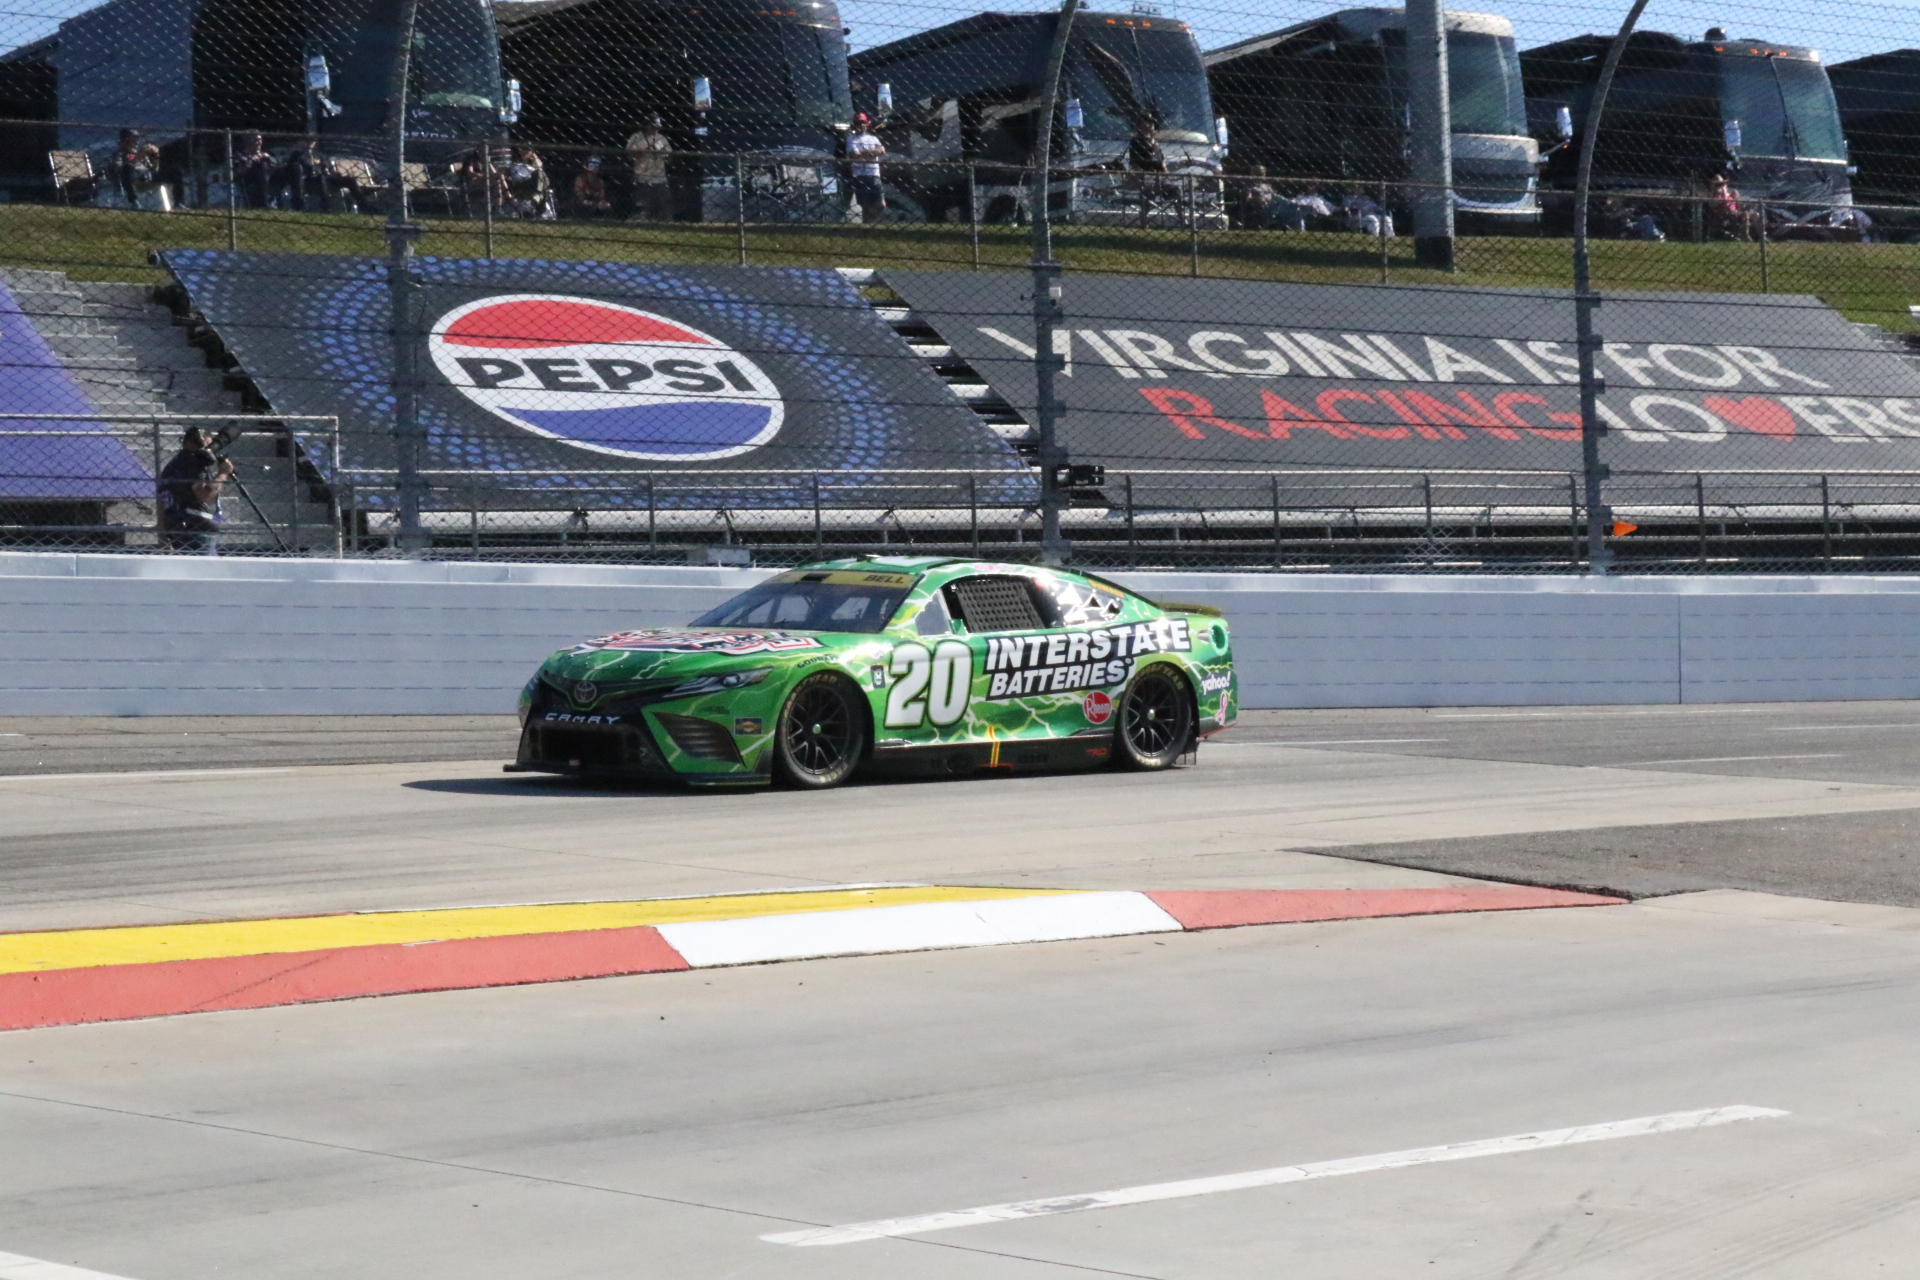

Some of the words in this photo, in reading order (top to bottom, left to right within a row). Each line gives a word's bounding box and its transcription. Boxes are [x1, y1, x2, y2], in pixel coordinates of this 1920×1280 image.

[454, 356, 757, 392] PEPSI
[977, 327, 1515, 383] VIRGINIA
[1492, 338, 1601, 384] IS
[1601, 341, 1832, 389] FOR
[1138, 387, 1584, 441] RACING
[863, 574, 905, 584] BELL
[986, 619, 1190, 671] INTERSTATE
[884, 639, 973, 729] 20
[990, 658, 1127, 697] BATTERIES
[1201, 670, 1231, 696] yahoo!
[544, 712, 621, 725] CAMRY
[1086, 692, 1111, 719] Rheem
